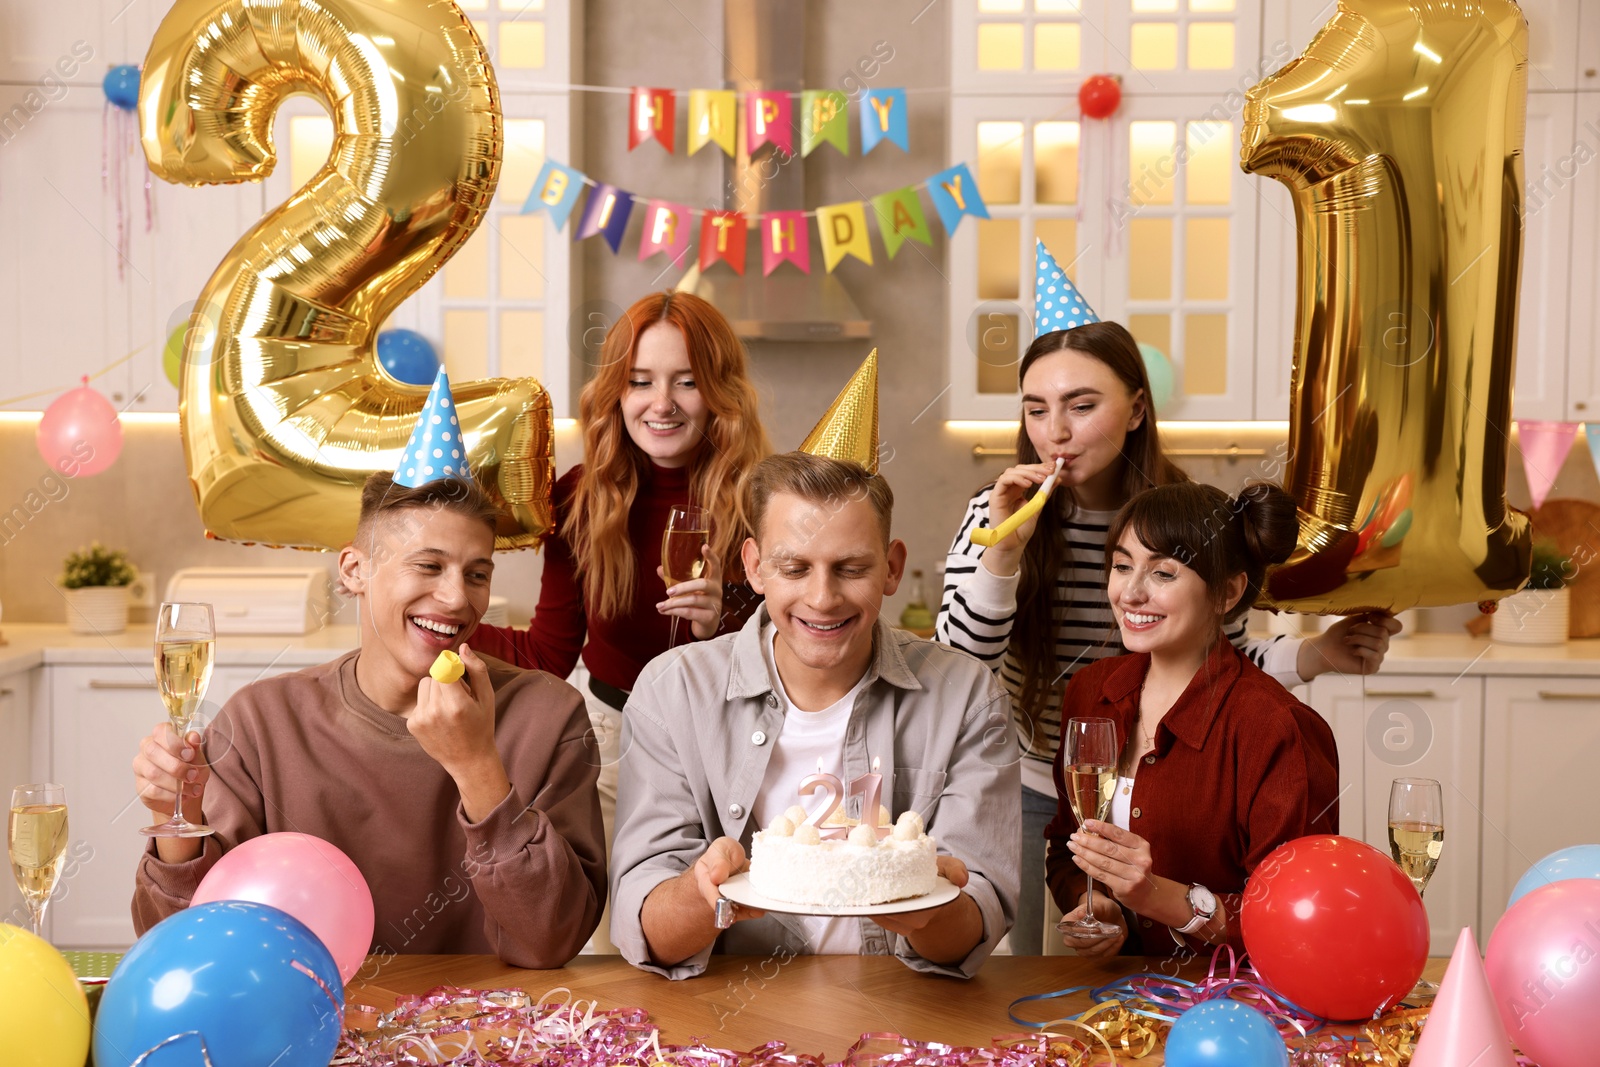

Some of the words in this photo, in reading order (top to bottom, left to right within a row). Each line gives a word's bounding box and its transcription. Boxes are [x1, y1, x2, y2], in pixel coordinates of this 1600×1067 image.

[638, 95, 893, 134] HAPPY
[541, 169, 966, 253] BIRTHDAY
[798, 773, 890, 840] 21
